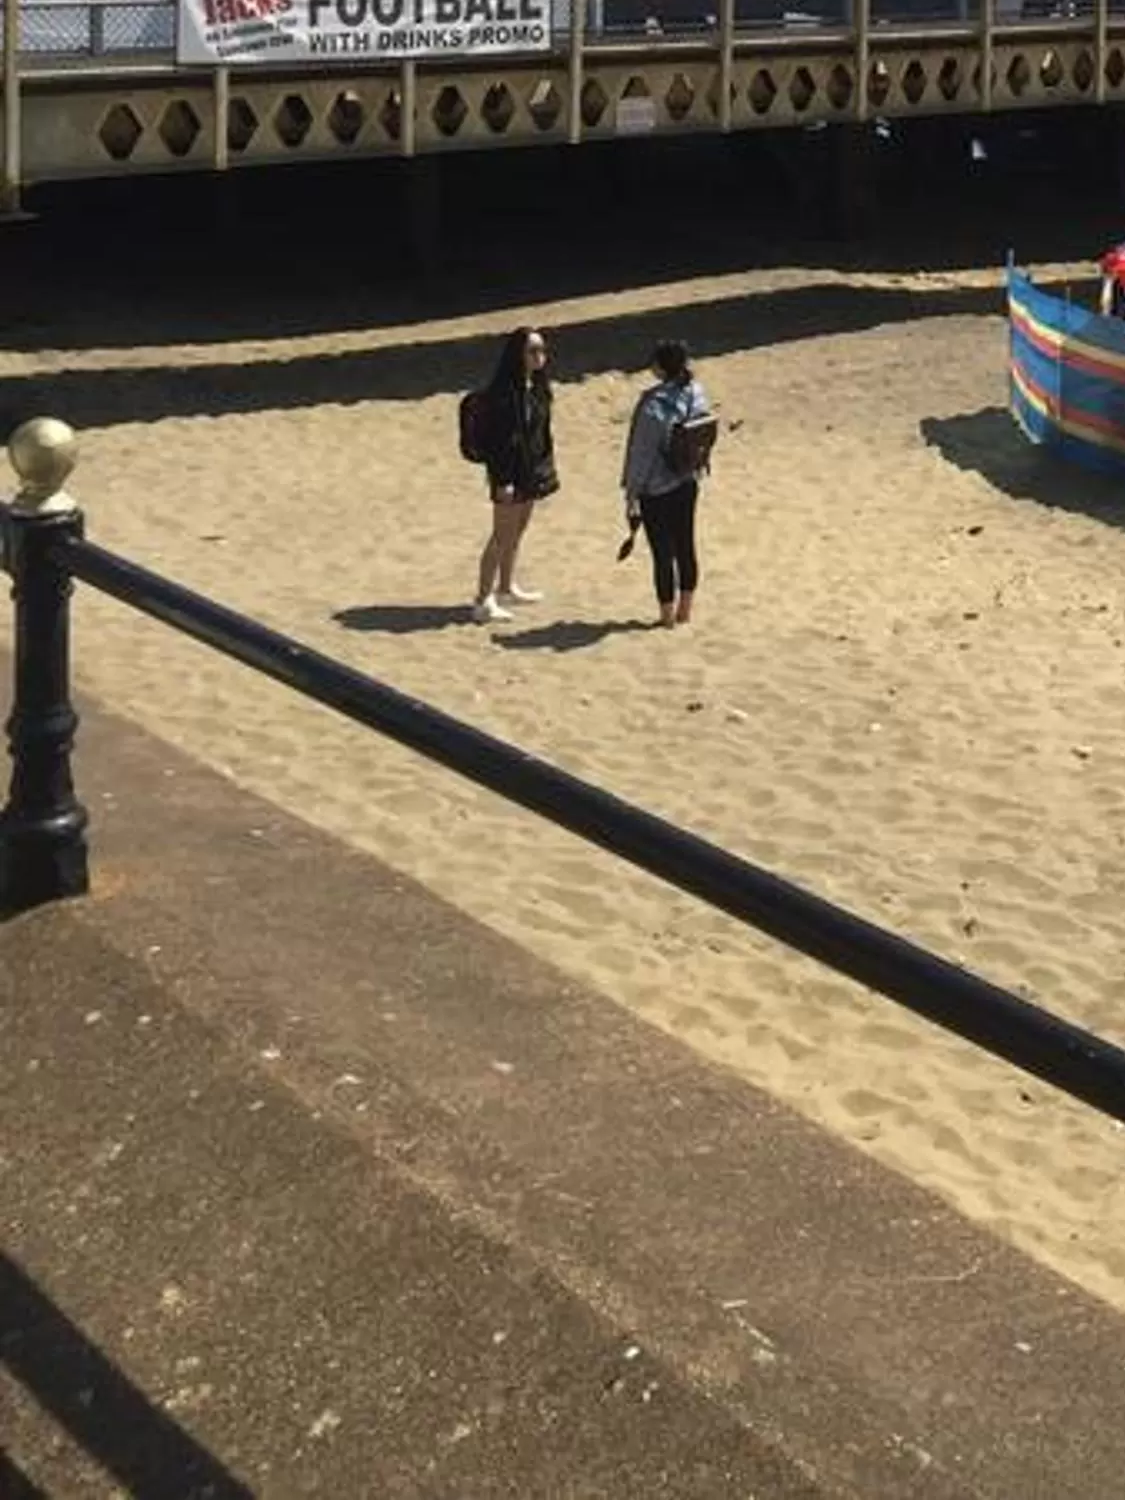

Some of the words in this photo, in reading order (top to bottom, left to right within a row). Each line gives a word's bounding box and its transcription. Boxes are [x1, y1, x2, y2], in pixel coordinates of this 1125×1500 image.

[309, 31, 370, 53] WITH
[377, 27, 463, 51] DRINKS
[465, 23, 545, 45] PROMO
